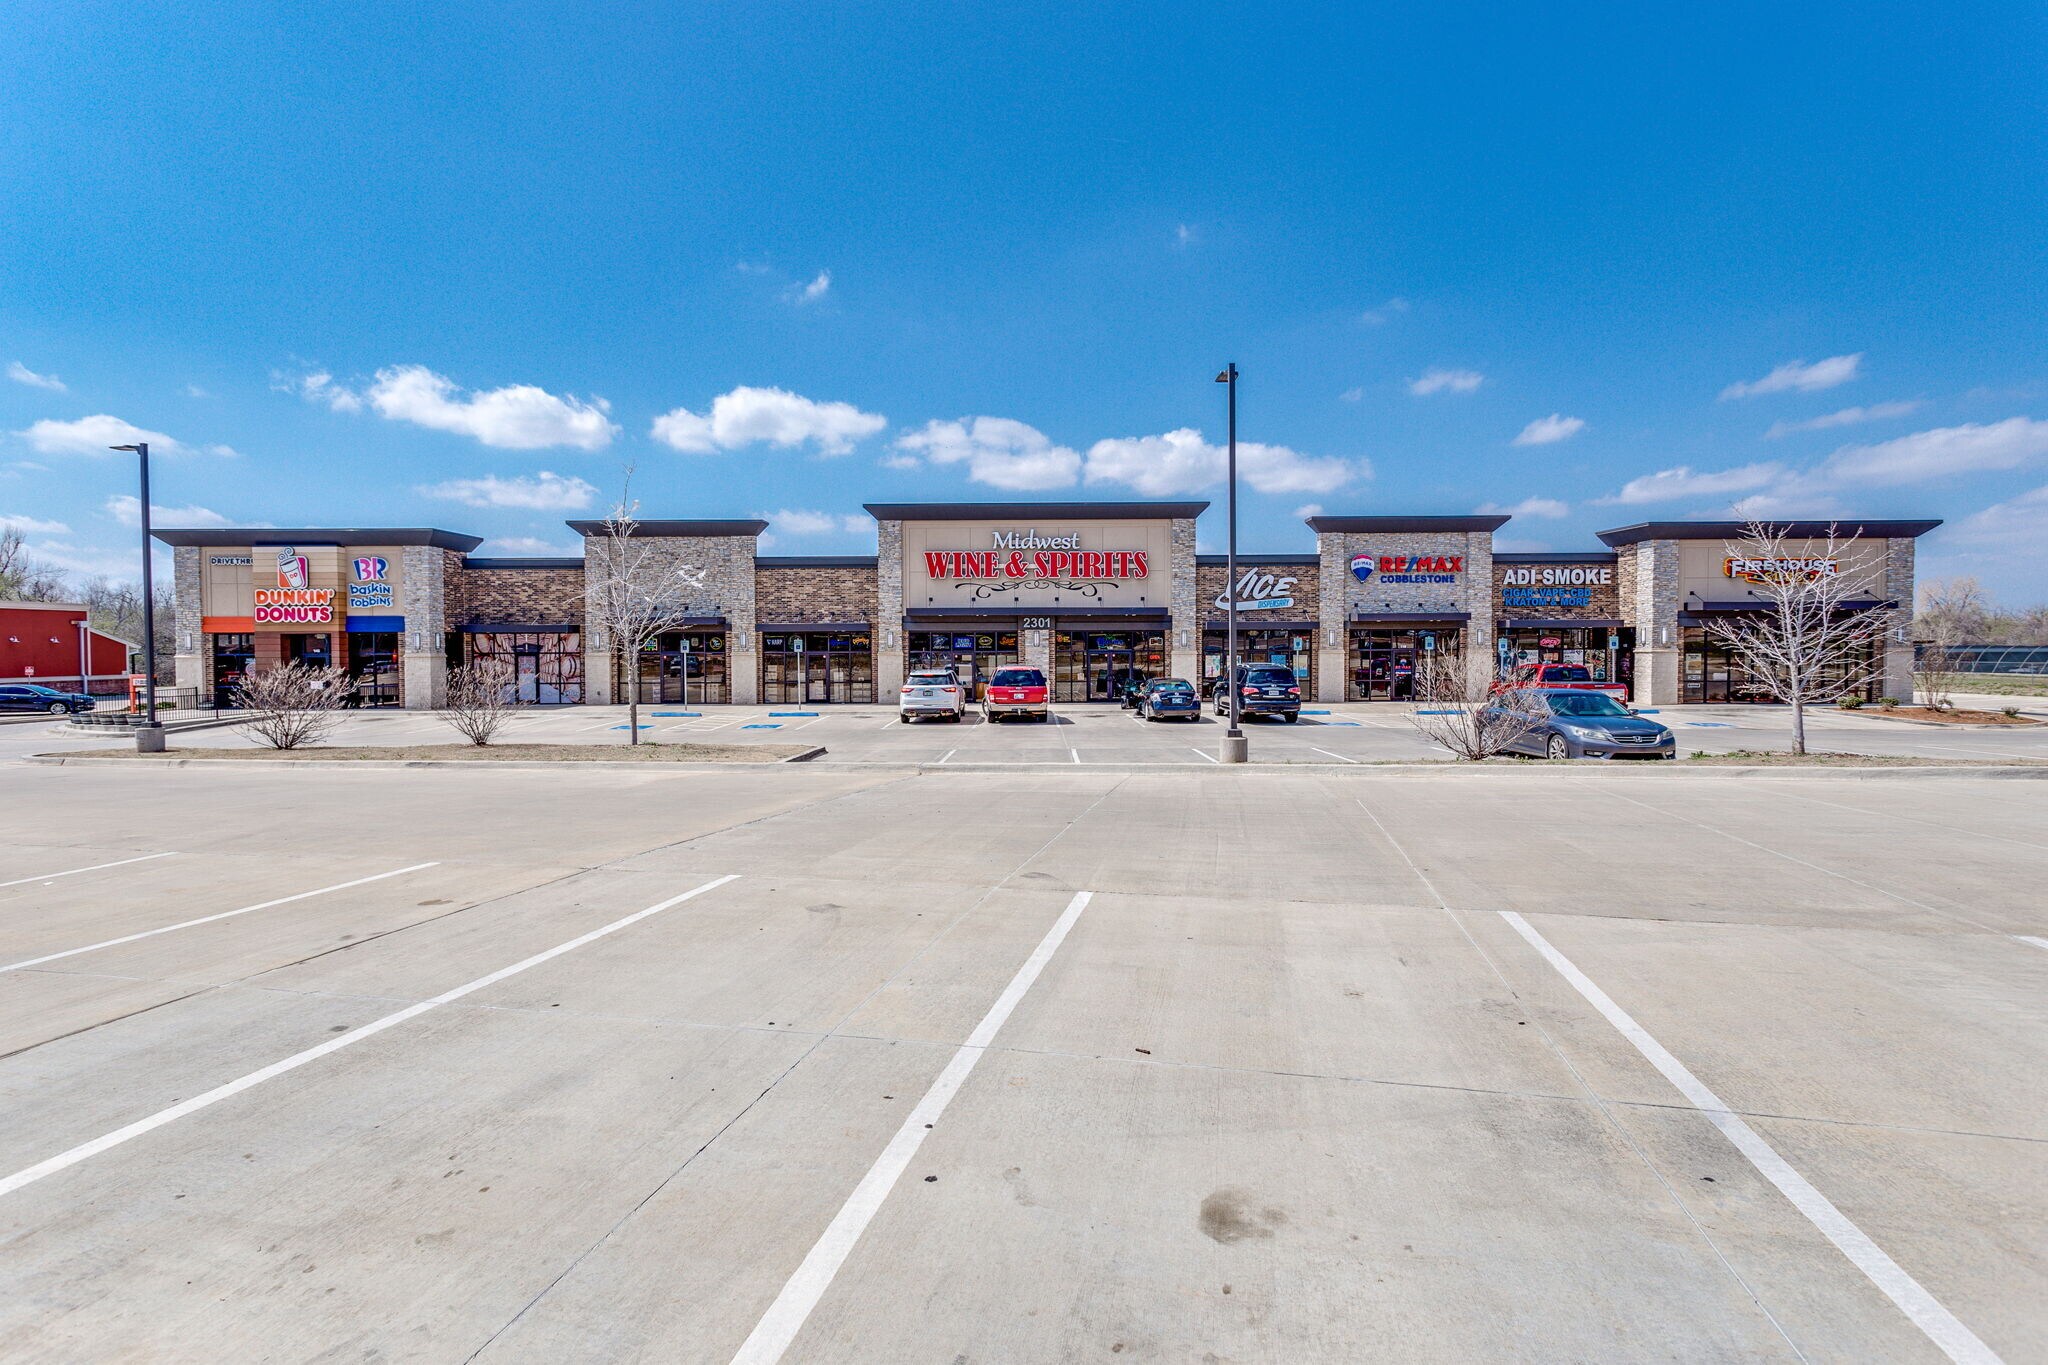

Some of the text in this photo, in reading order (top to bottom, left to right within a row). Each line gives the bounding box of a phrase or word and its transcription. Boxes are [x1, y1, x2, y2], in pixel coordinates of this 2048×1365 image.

[992, 529, 1080, 549] Midwest
[211, 557, 235, 565] DRIVE
[924, 551, 1149, 579] WINE & SPIRITS
[1379, 556, 1463, 572] RE/MAX
[353, 557, 388, 581] BR
[1730, 560, 1837, 577] FIREHOUSE
[1380, 575, 1455, 584] COBBLESTONE
[1503, 569, 1612, 585] ADI SMOKE
[350, 583, 392, 595] baskin
[1502, 589, 1591, 597] CIGAR VAPE CBD
[255, 590, 334, 605] DUNKIN'
[351, 596, 392, 607] robbins
[1258, 600, 1289, 608] DISPENSARY
[1505, 598, 1589, 606] KRATOM & MORE
[256, 607, 331, 622] DONUTS
[1023, 617, 1050, 628] 2301
